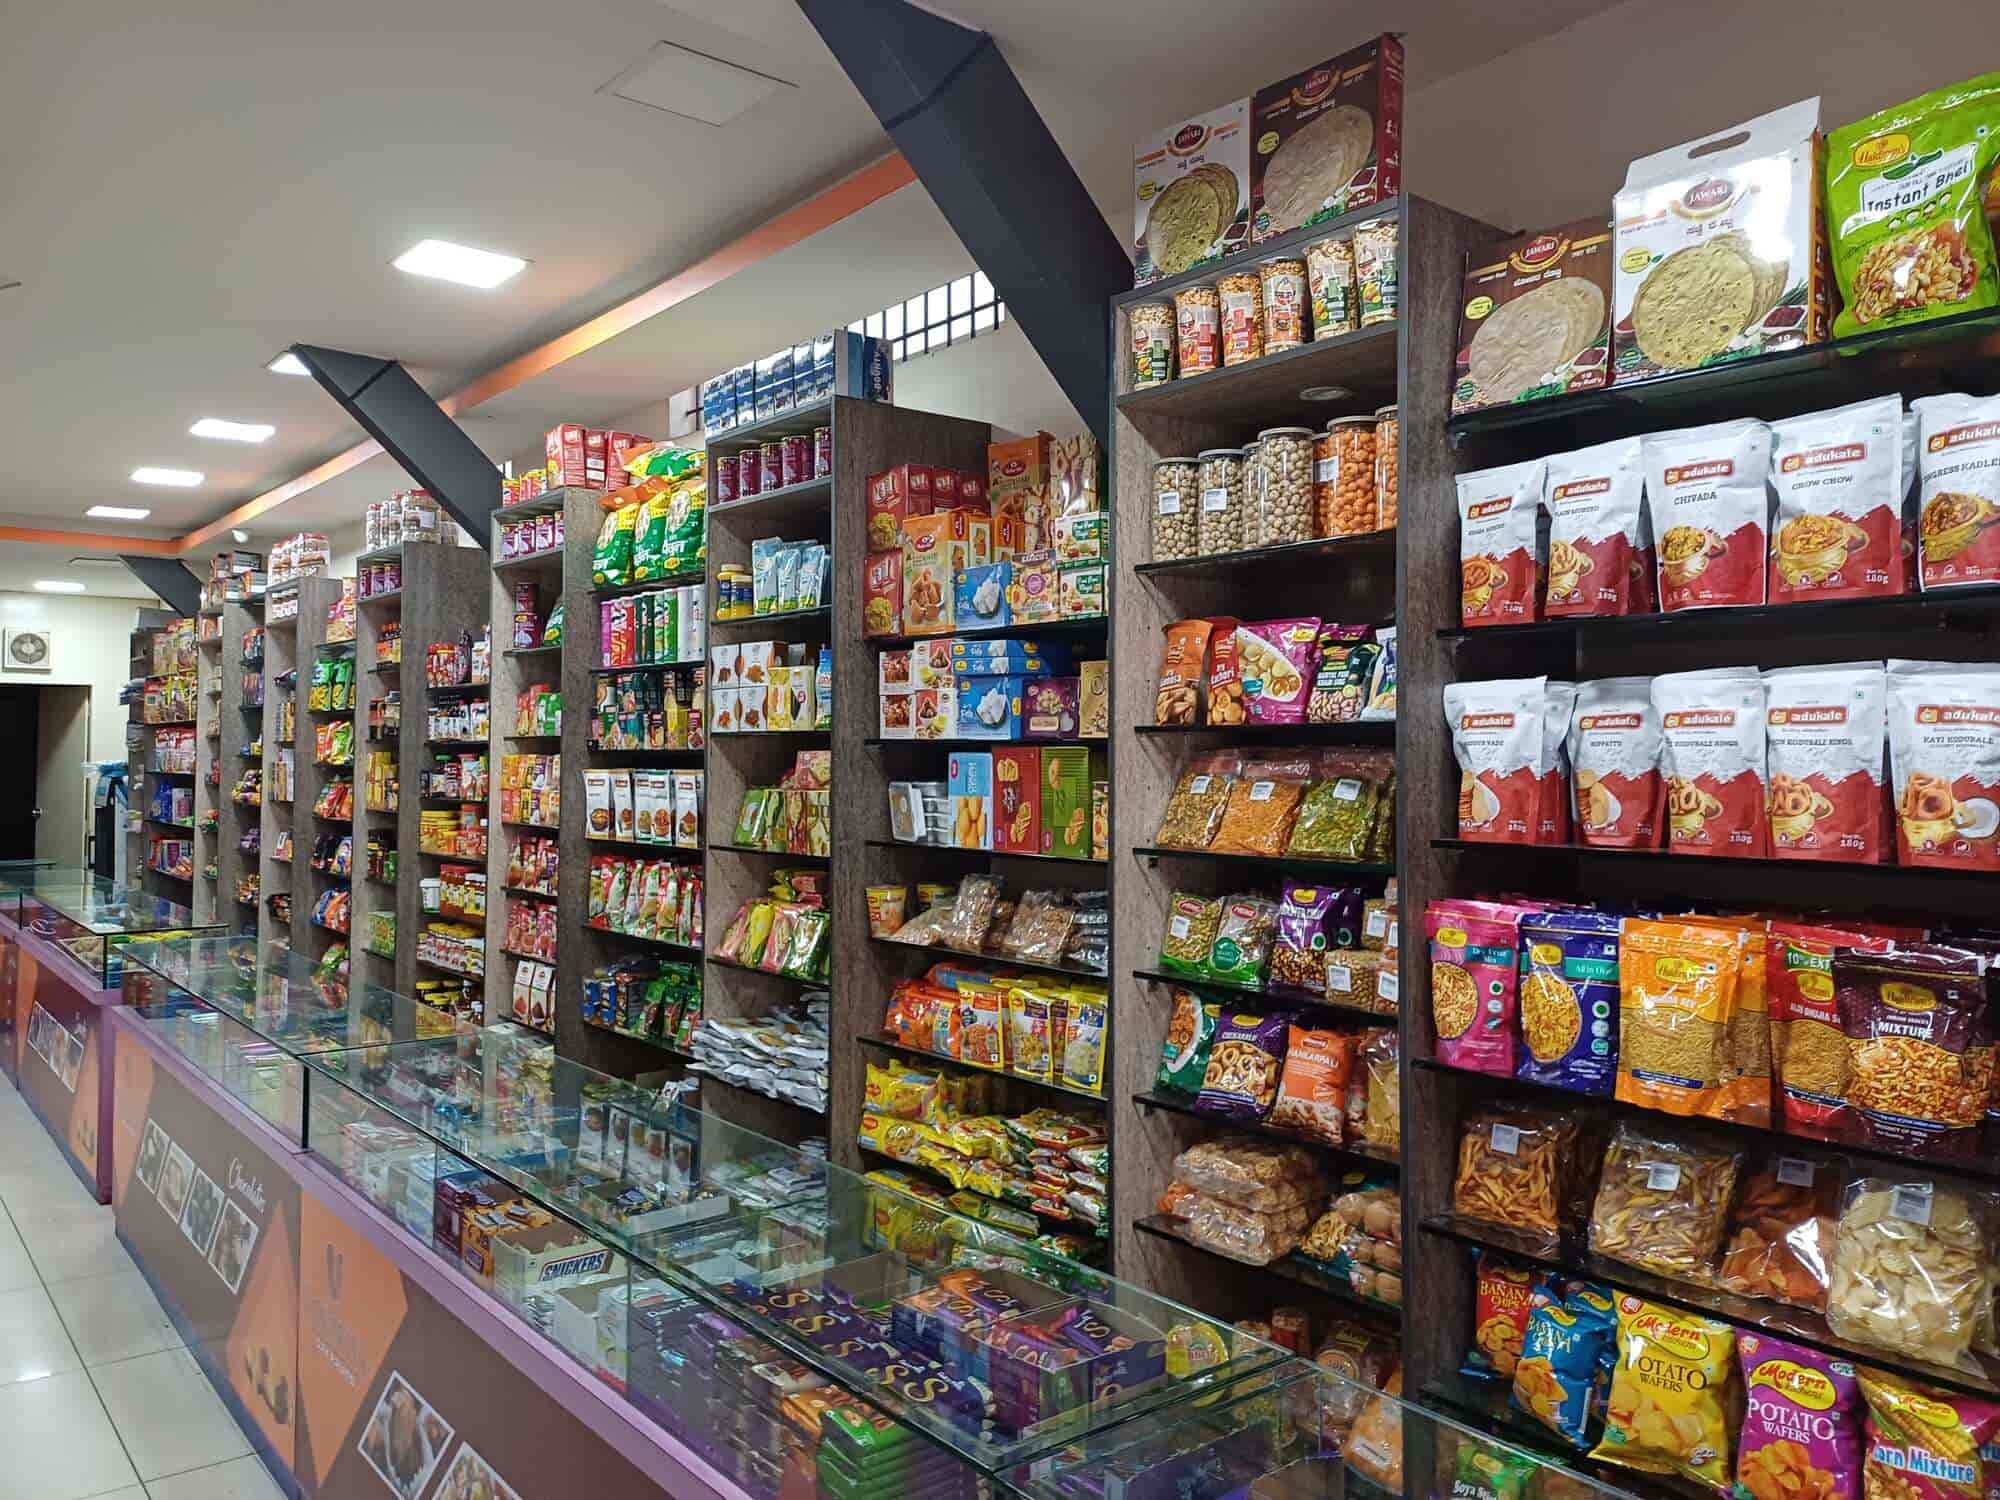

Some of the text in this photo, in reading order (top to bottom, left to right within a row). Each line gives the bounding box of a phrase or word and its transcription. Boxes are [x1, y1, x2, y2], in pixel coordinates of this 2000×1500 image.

[1689, 184, 1729, 205] JAWARI
[1867, 186, 1930, 212] Instant
[1935, 160, 1970, 188] Bhel
[1805, 446, 1863, 466] adukale
[1684, 462, 1730, 480] adukale
[1674, 490, 1718, 506] CHIVADA
[1683, 711, 1732, 725] adukale
[1791, 710, 1842, 722] adukale
[1878, 1021, 1934, 1040] MIXTURE
[543, 1252, 604, 1281] SNICKERS
[1636, 1315, 1701, 1342] Modern
[1638, 1374, 1684, 1394] WAFERS
[1758, 1363, 1828, 1391] Modern
[1748, 1397, 1836, 1441] POTATO
[1761, 1420, 1812, 1445] WAFERS
[1909, 1447, 1976, 1483] Mixture
